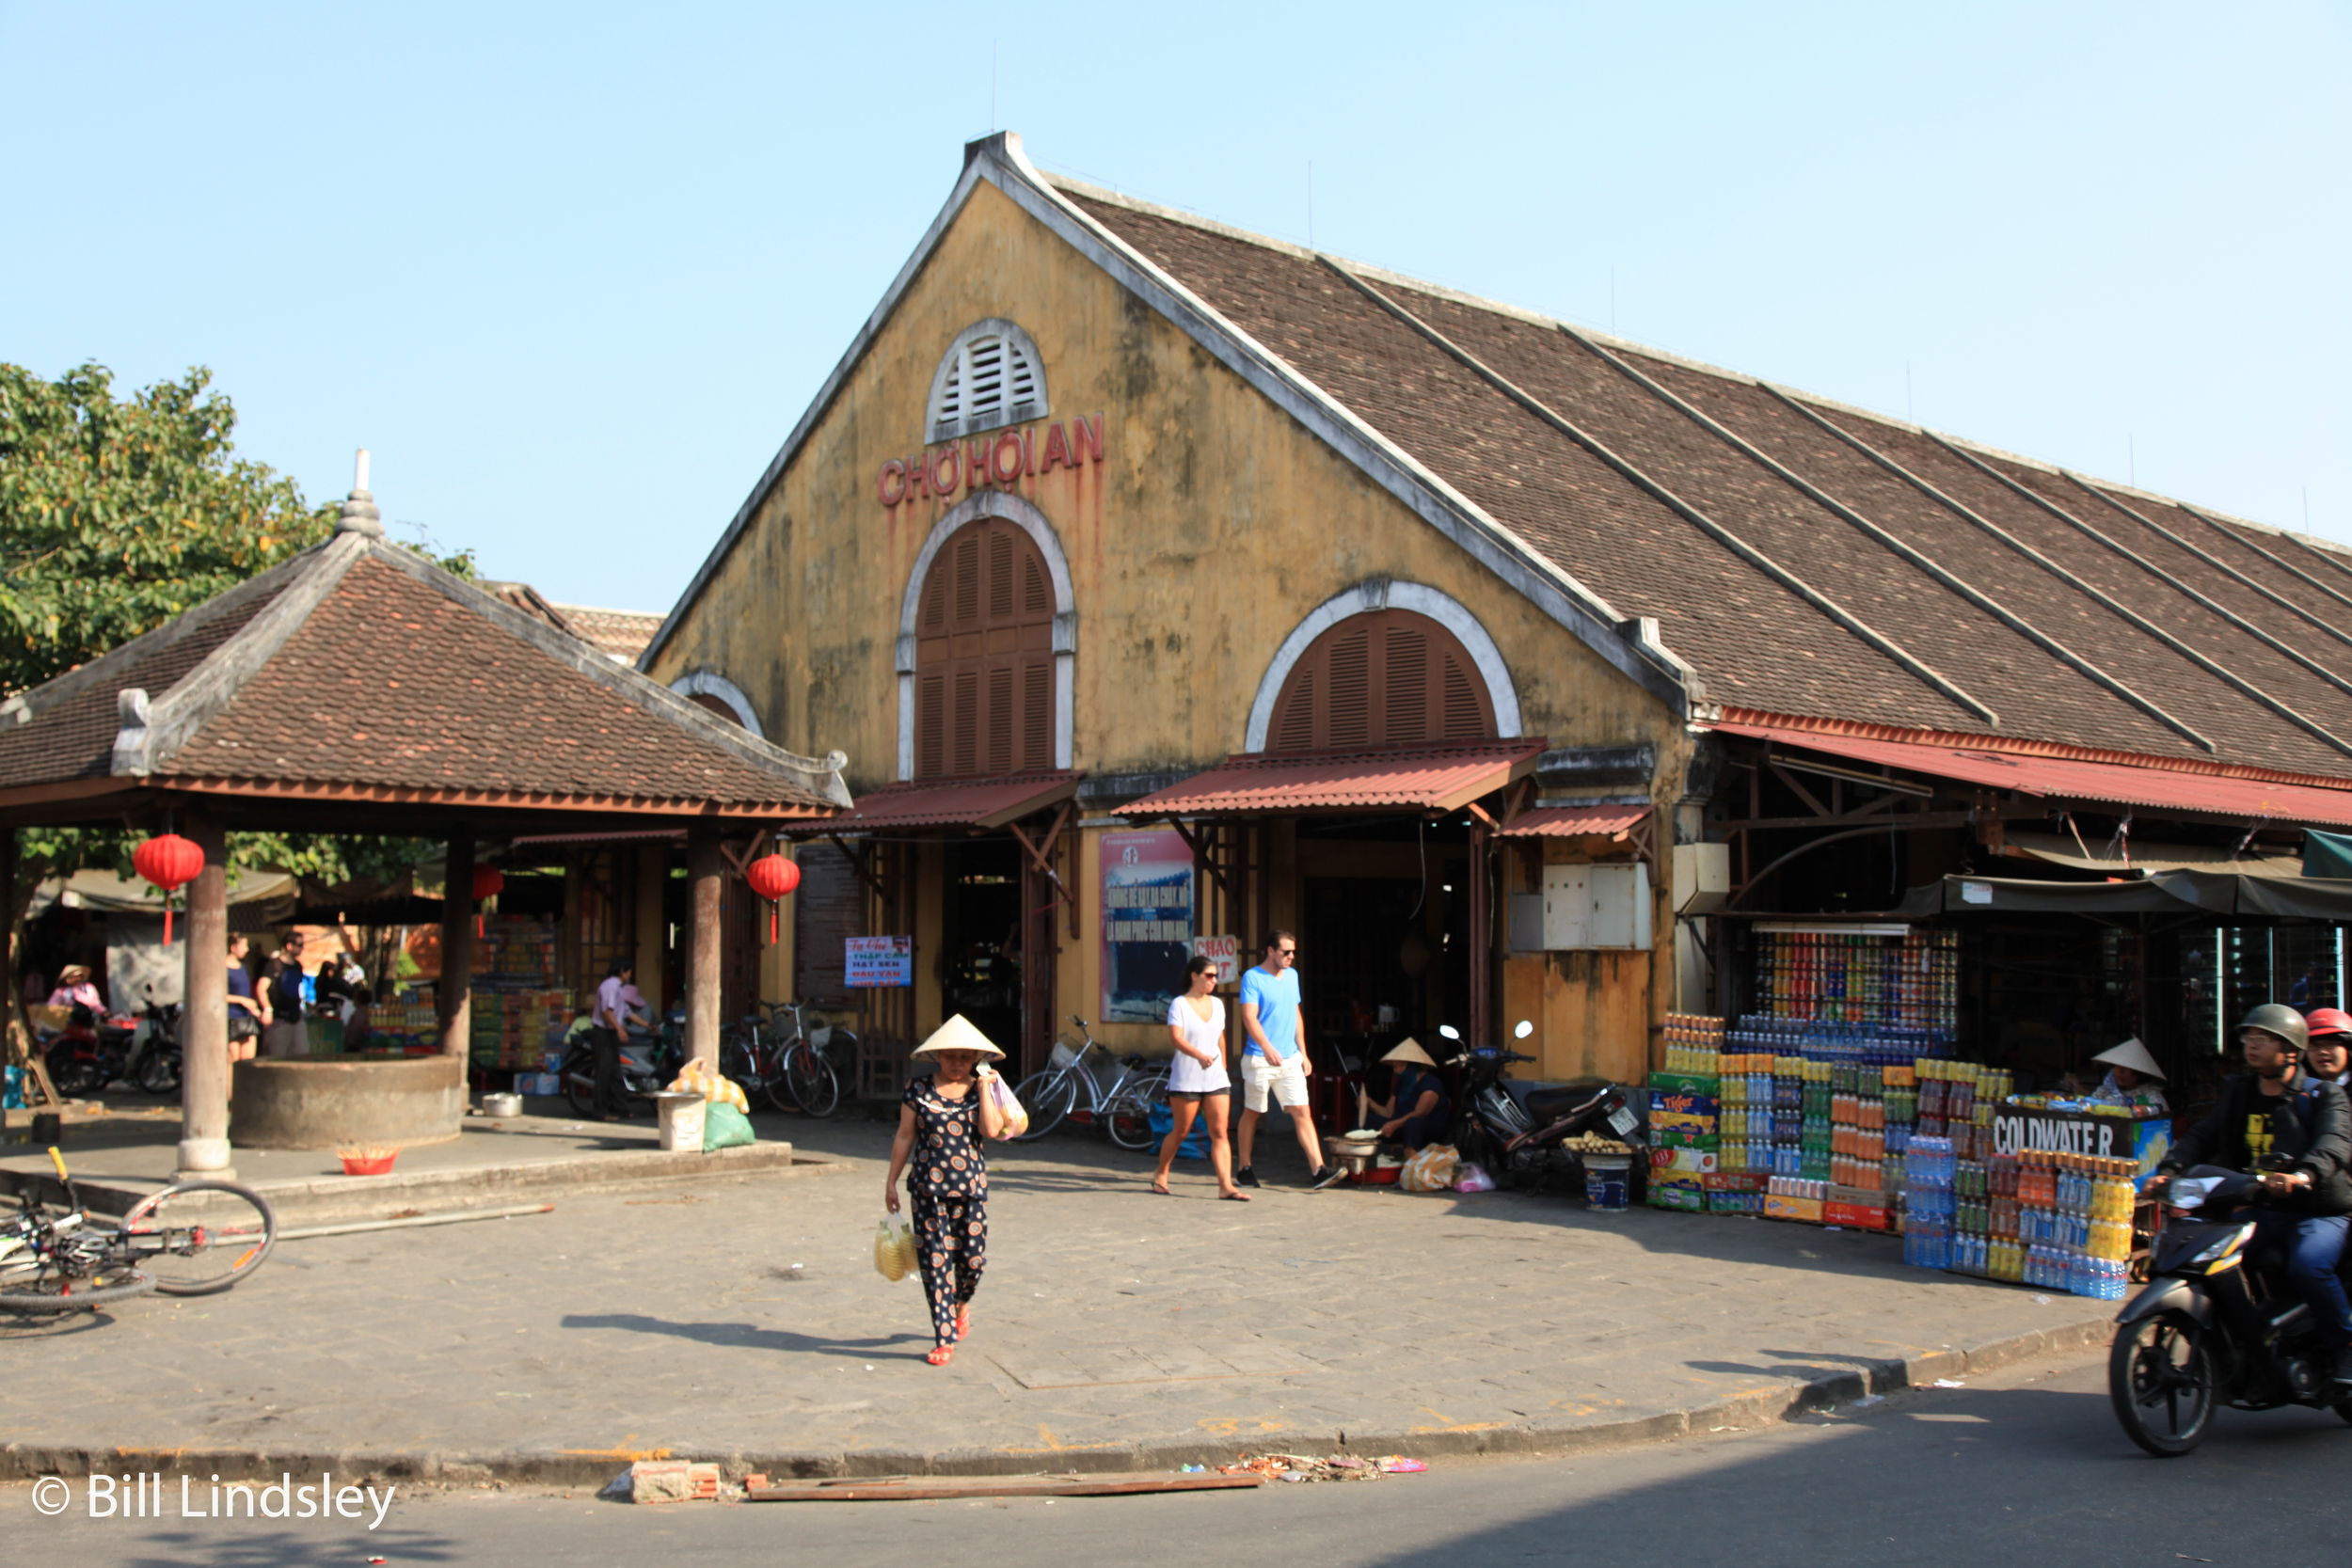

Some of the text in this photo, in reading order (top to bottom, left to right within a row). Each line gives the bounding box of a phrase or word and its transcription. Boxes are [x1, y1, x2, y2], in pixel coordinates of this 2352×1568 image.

[878, 411, 1104, 505] CHỢ HỘI AN
[1663, 1095, 1693, 1114] Tiger
